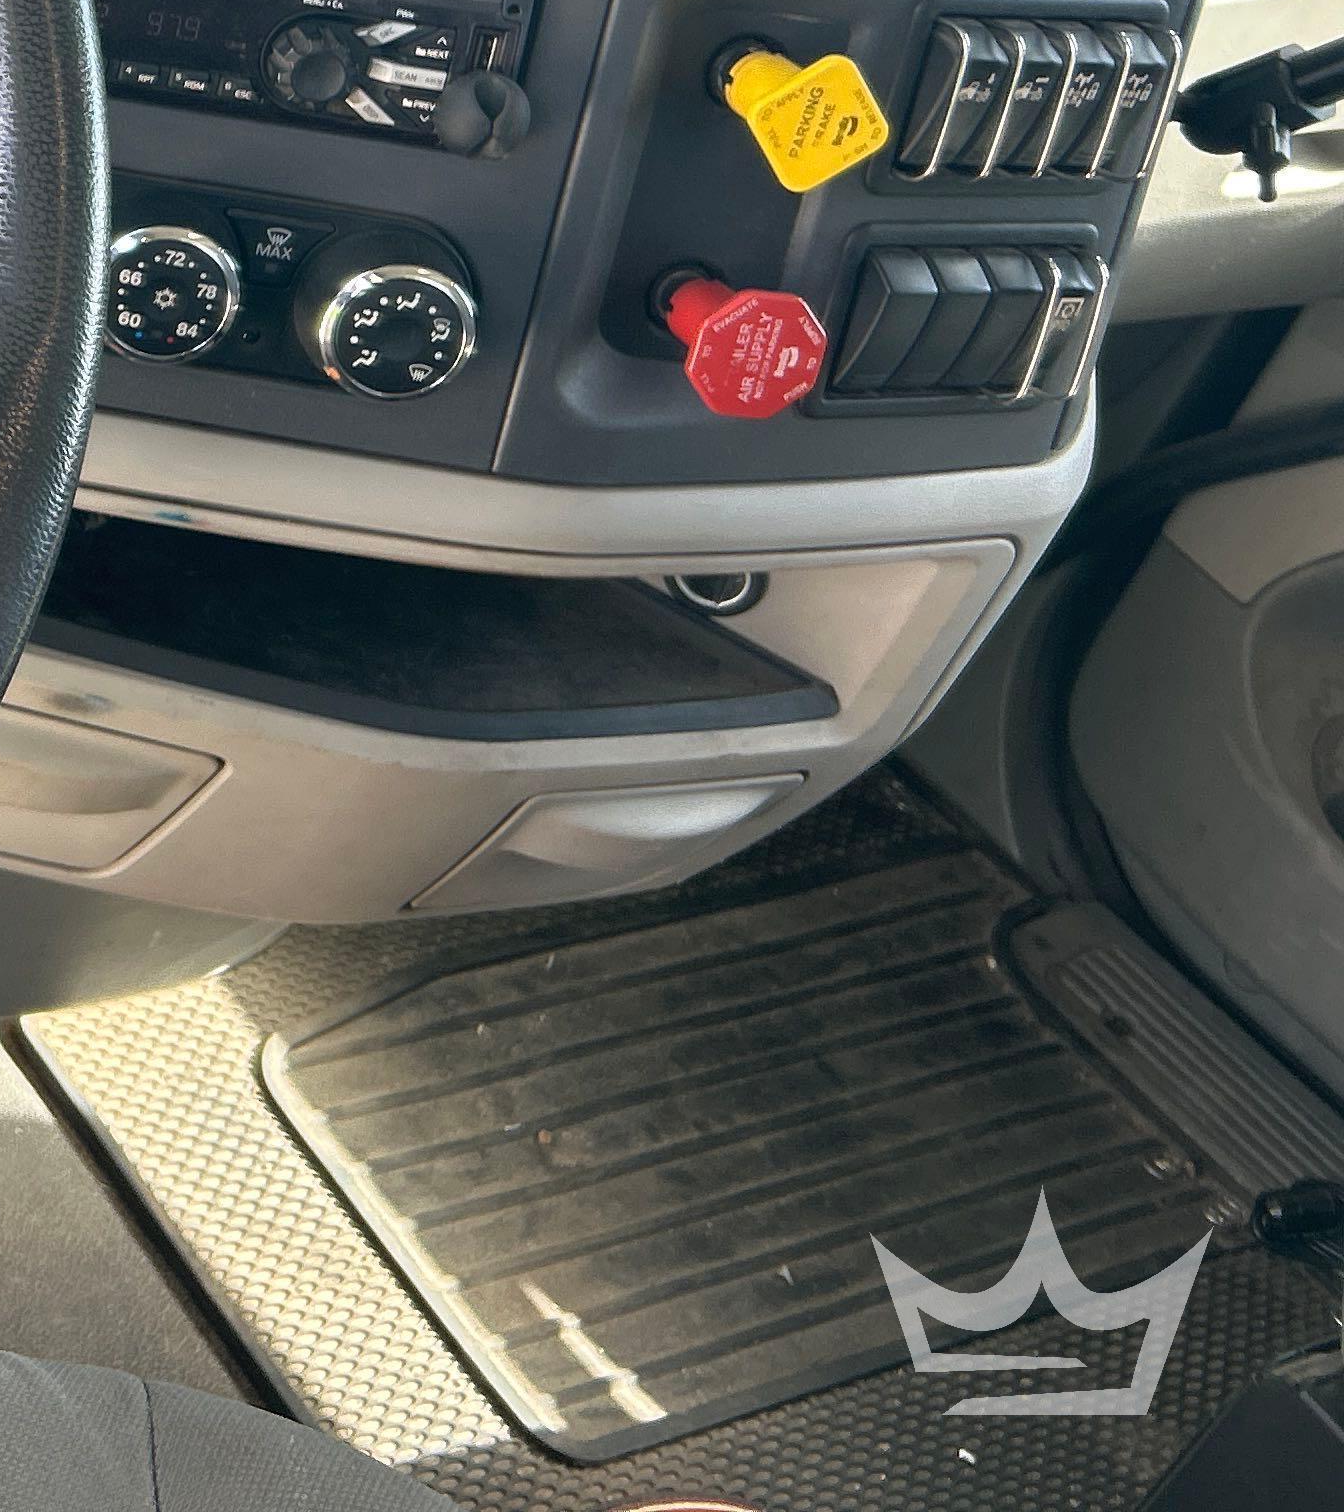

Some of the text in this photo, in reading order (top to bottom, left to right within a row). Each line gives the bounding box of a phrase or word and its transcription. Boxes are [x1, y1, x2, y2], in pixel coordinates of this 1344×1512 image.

[788, 86, 824, 159] PARKING
[812, 102, 837, 147] BRAKE
[164, 249, 186, 268] 72
[255, 241, 294, 262] MAX
[118, 268, 143, 287] 66
[195, 283, 218, 301] 78
[117, 311, 142, 330] 60
[712, 296, 759, 334] EVACUATE
[175, 321, 200, 339] 84
[738, 311, 773, 403] AIR SUPPLY
